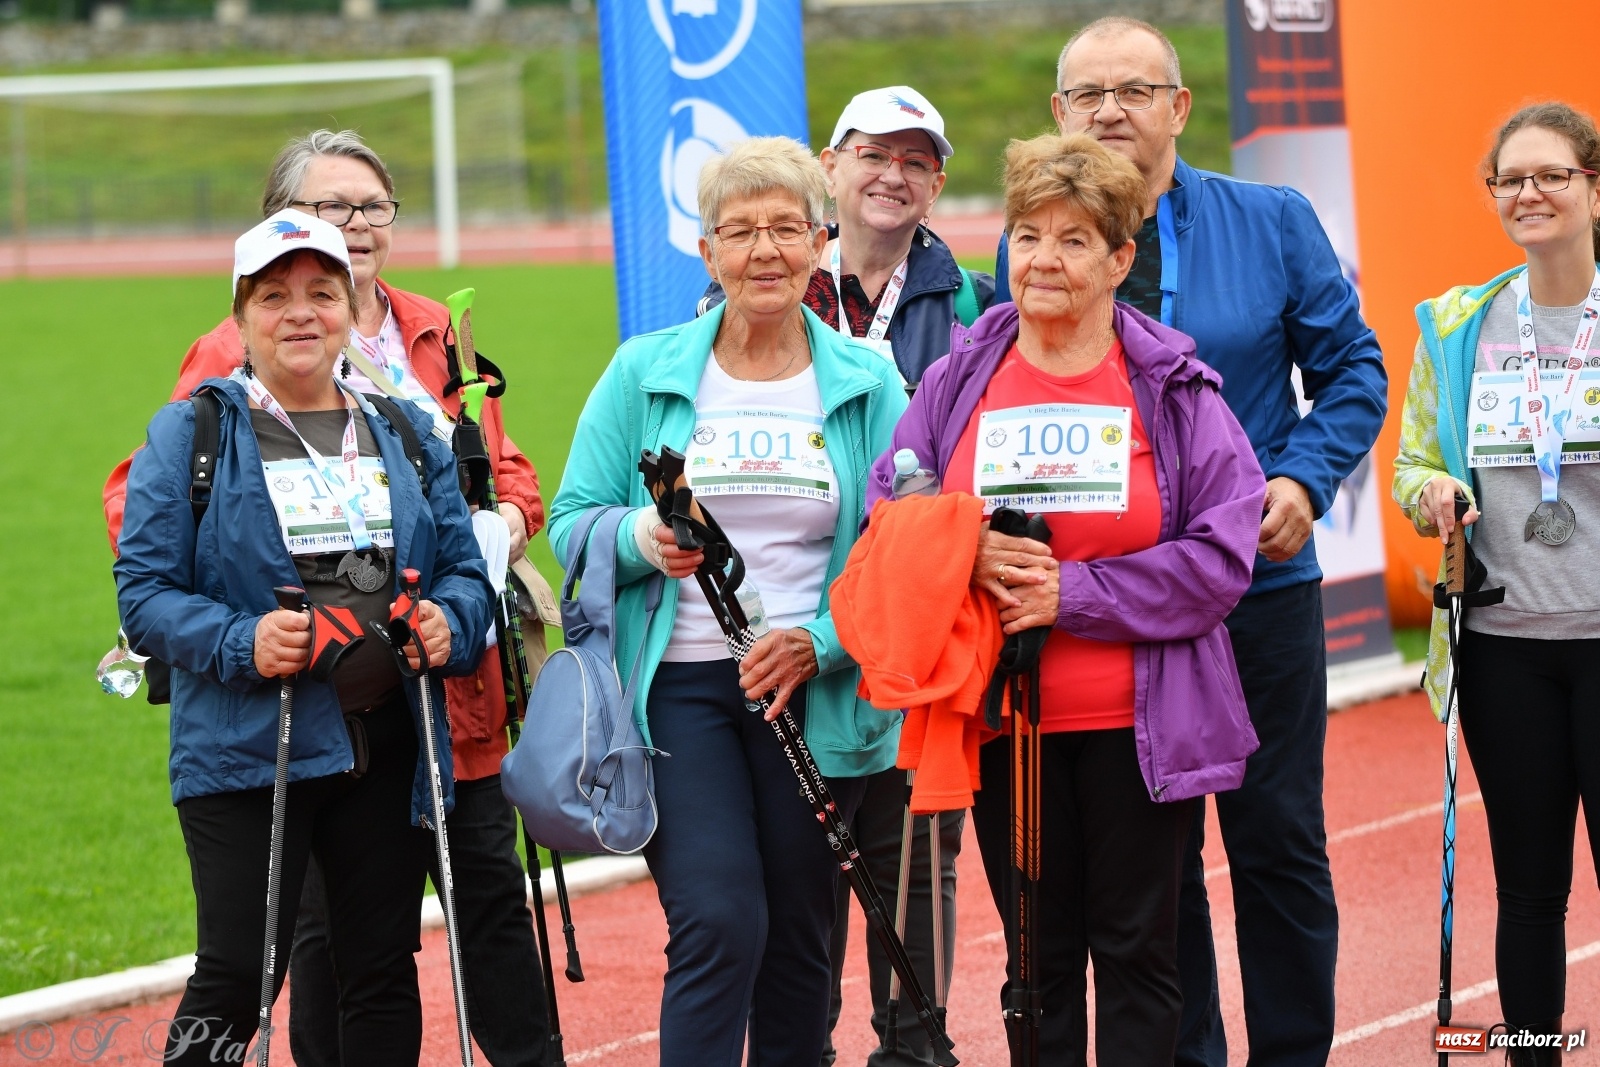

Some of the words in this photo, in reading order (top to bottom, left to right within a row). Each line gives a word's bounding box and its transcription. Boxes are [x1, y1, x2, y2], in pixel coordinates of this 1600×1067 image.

[727, 430, 796, 461] 101
[1017, 423, 1090, 456] 100
[281, 713, 292, 744] viking
[784, 744, 817, 804] WALKING
[796, 736, 827, 794] WALKING
[267, 944, 276, 974] viking
